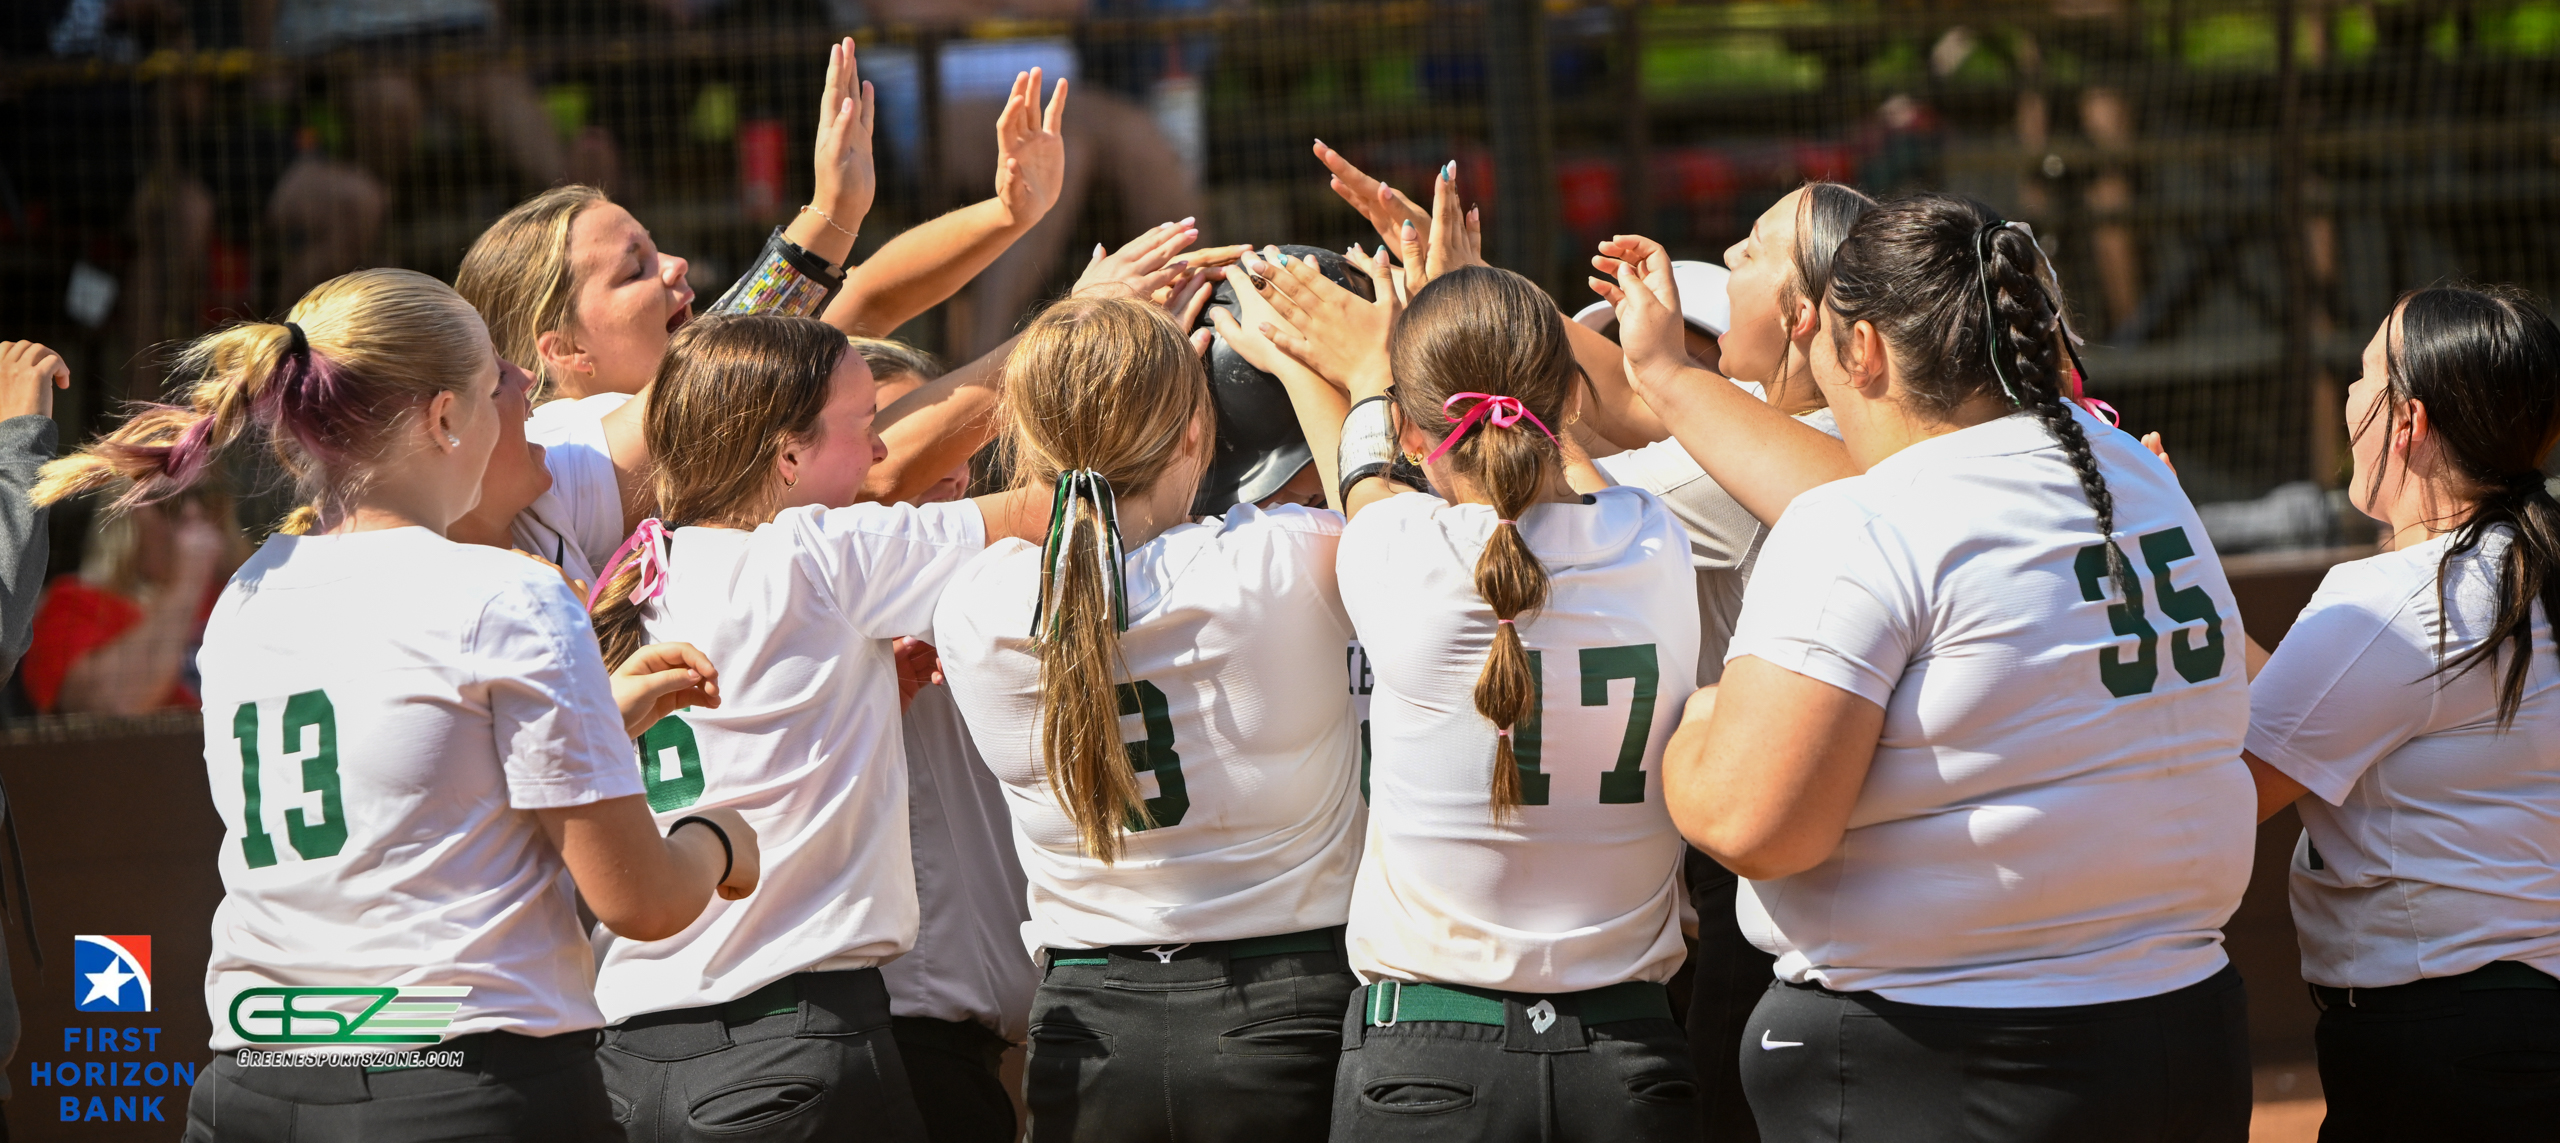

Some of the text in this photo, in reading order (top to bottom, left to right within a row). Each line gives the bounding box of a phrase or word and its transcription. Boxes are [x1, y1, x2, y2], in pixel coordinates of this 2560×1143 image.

[2073, 526, 2226, 699] 35
[232, 687, 349, 870] 13
[1511, 643, 1660, 806] 17
